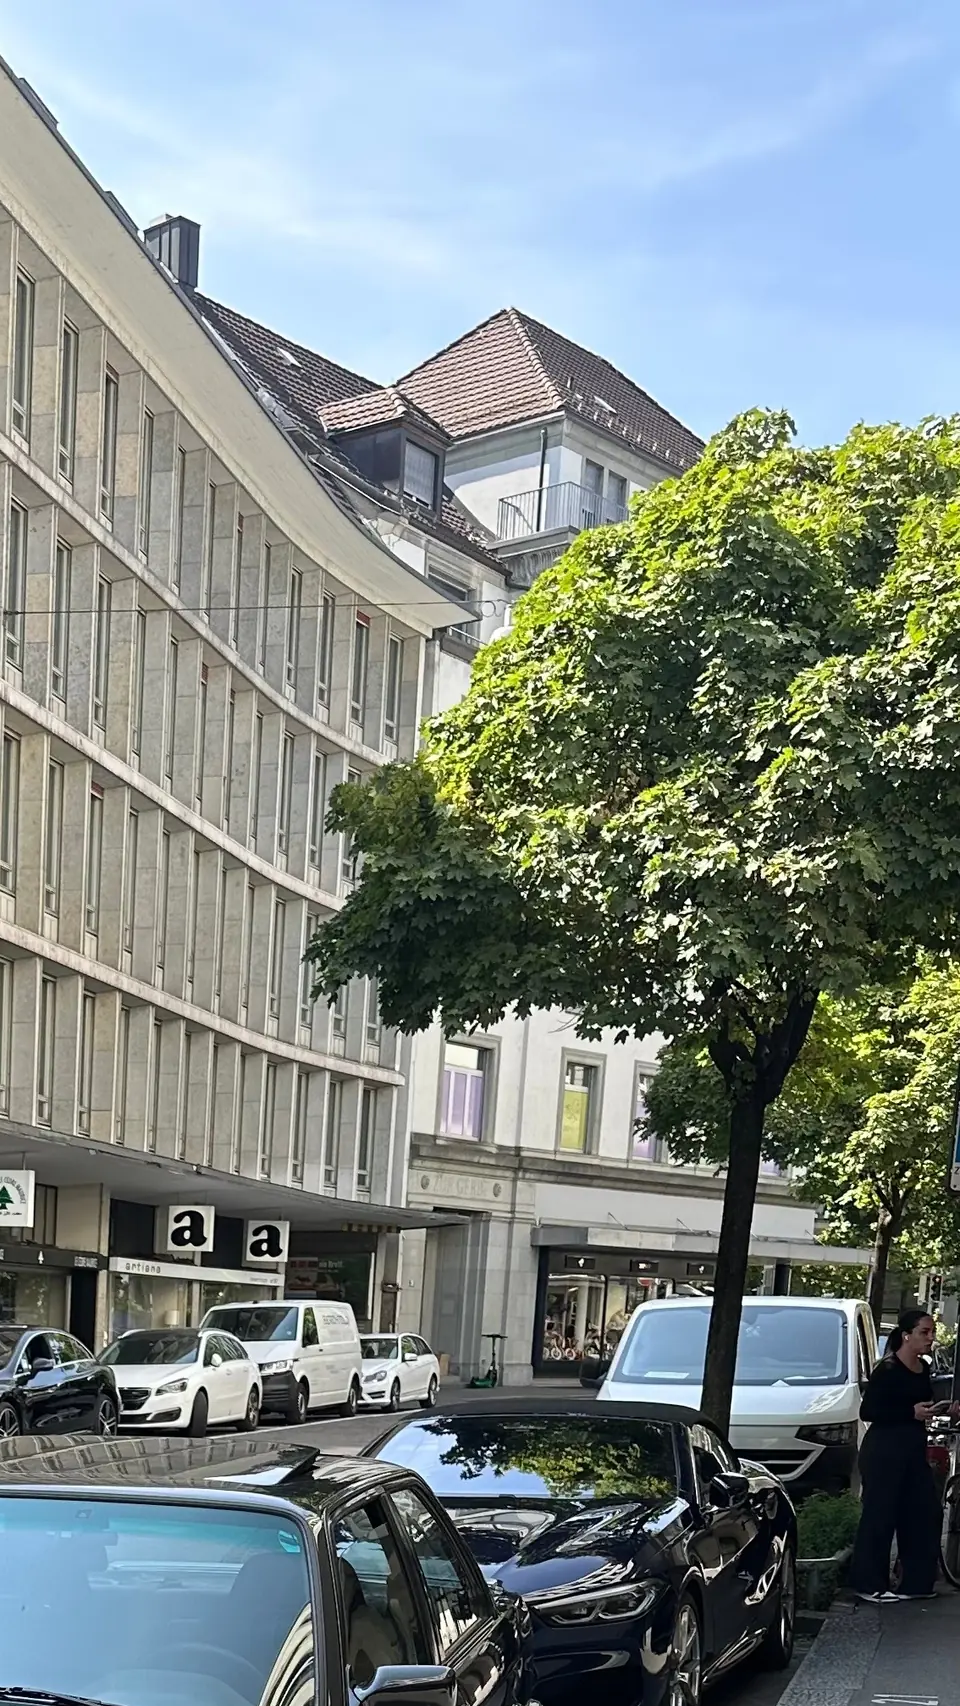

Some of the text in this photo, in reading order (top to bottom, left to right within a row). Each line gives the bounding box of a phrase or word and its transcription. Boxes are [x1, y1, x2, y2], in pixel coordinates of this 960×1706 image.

[171, 1210, 208, 1247] a
[249, 1224, 283, 1257] a
[125, 1261, 161, 1274] artiana
